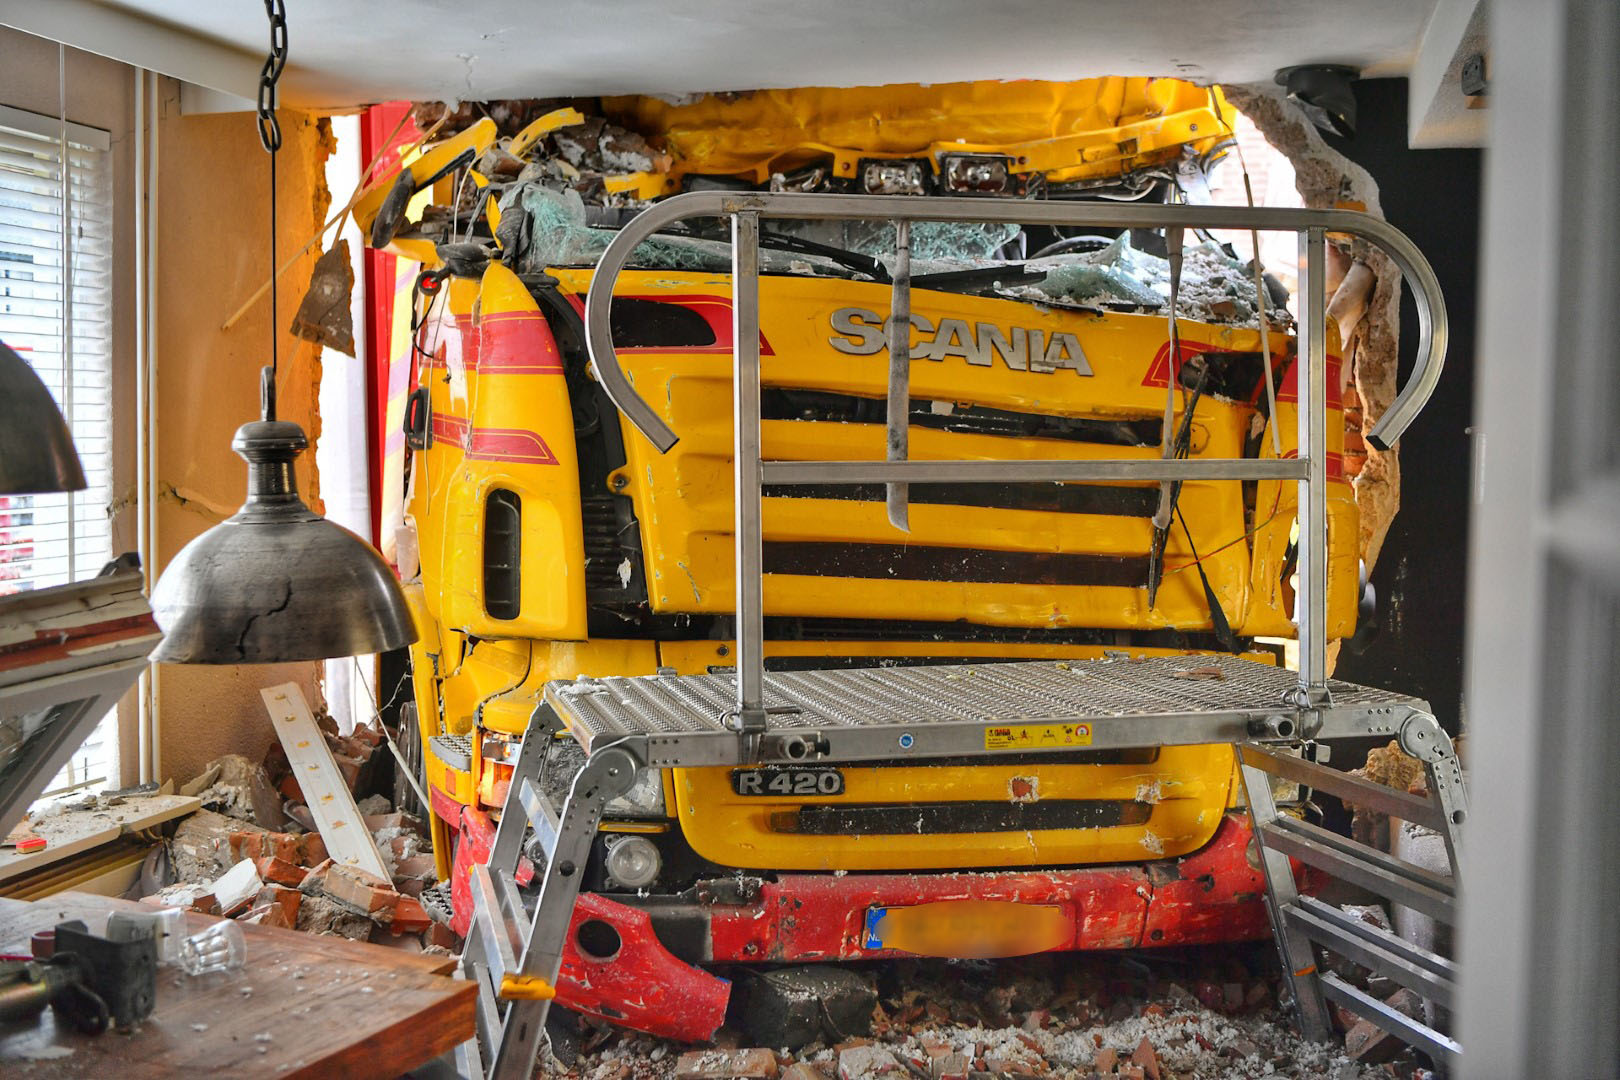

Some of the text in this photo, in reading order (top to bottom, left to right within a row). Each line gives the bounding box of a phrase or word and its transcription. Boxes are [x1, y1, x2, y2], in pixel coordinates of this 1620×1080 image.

[829, 307, 1094, 377] SCANIA
[739, 772, 841, 794] R 420
